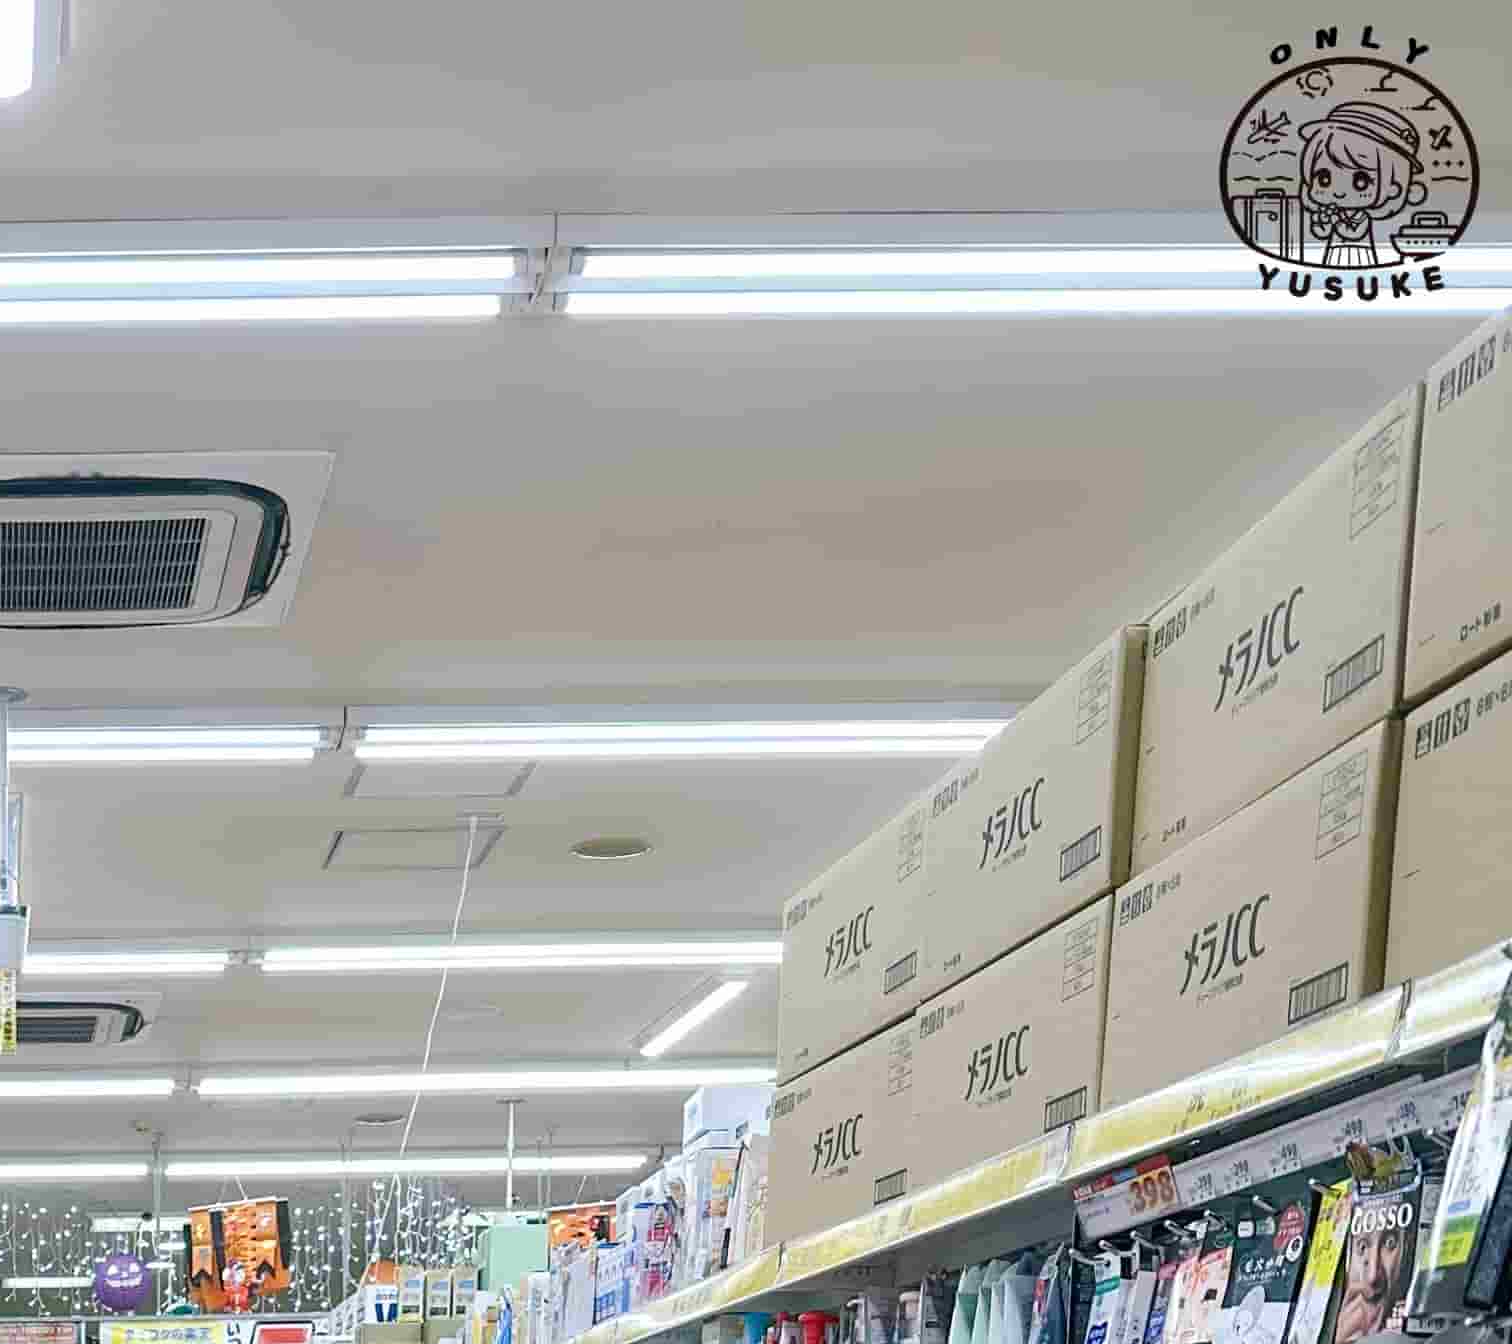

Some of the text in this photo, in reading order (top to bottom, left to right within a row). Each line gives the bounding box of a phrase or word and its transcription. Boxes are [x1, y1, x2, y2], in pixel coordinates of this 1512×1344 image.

[1214, 585, 1304, 712] メラノCC
[978, 777, 1045, 870] メラノCC
[824, 905, 875, 978] メラノCC
[1180, 894, 1271, 995] メラノCC
[965, 1025, 1030, 1101] メラノCC
[810, 1113, 863, 1175] メラノCC
[1131, 1169, 1174, 1212] 398
